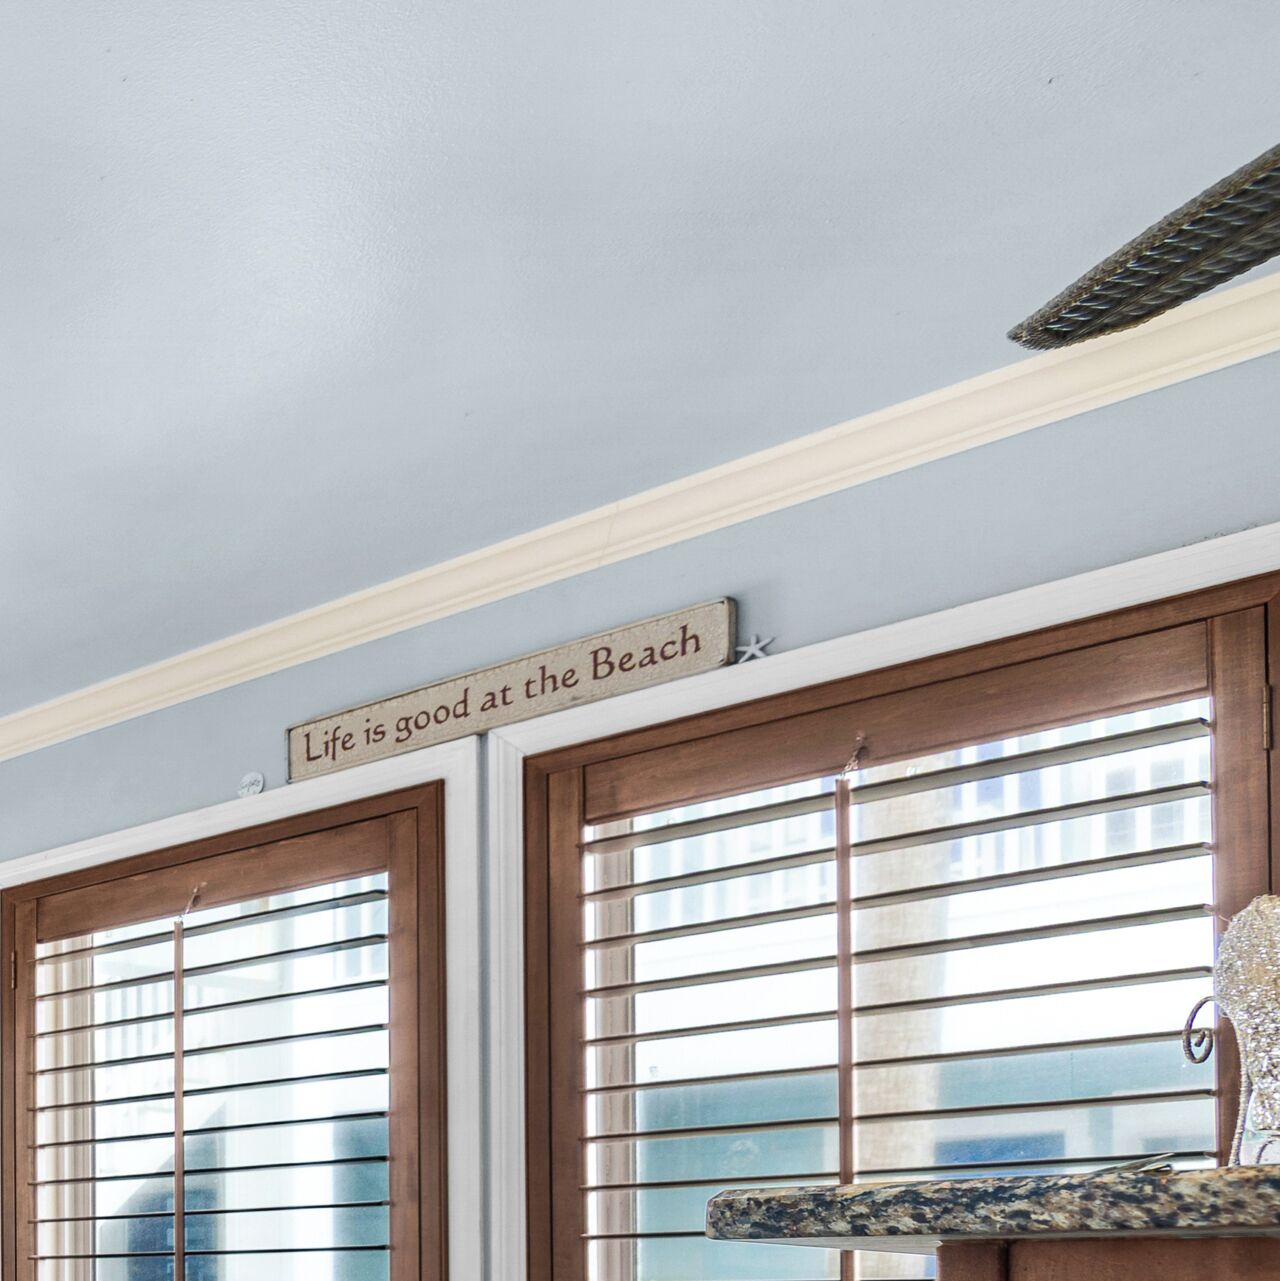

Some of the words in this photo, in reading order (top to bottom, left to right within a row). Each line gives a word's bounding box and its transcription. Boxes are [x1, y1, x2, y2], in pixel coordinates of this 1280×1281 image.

[303, 730, 356, 764] Life
[363, 716, 386, 745] is
[395, 688, 470, 743] good
[479, 687, 514, 712] at
[524, 665, 580, 700] the
[589, 624, 702, 681] Beach
